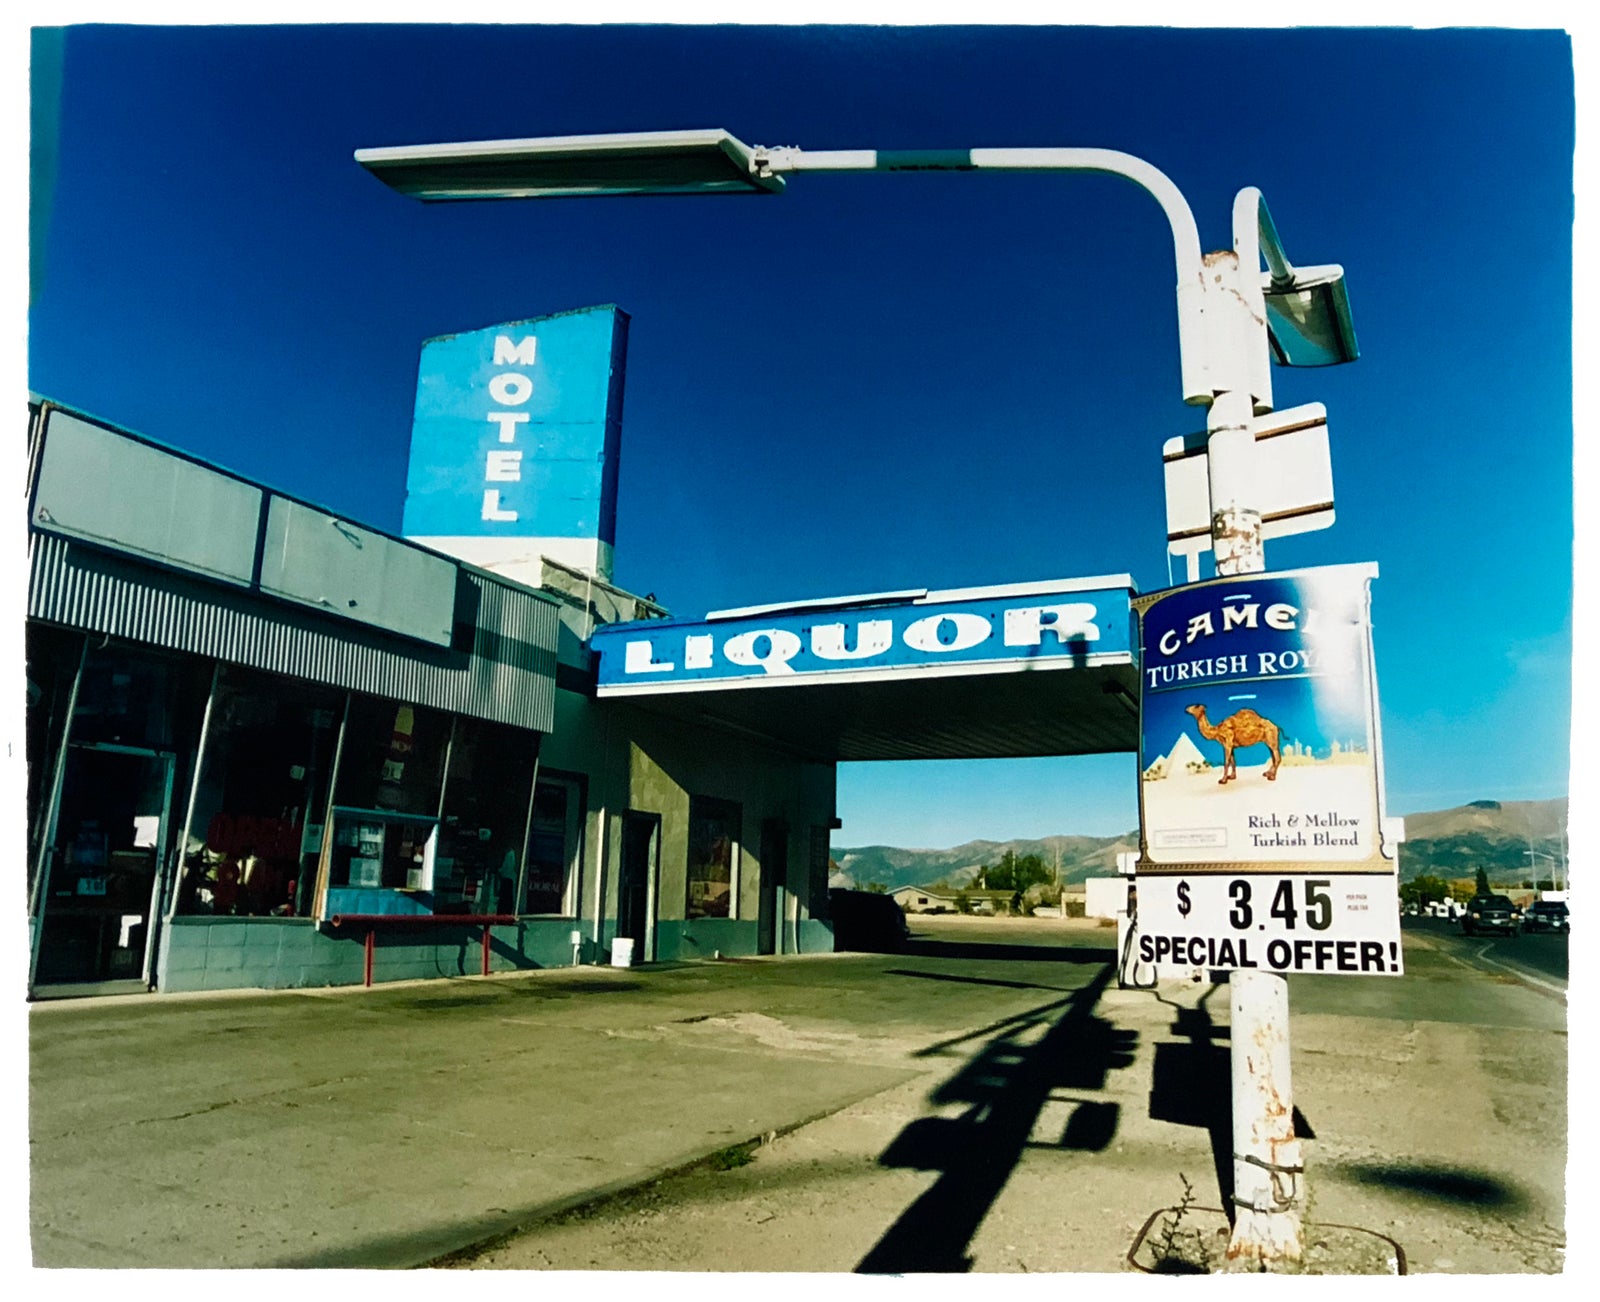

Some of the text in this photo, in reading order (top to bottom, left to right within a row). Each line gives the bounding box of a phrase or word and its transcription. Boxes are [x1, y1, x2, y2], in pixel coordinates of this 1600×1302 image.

[481, 335, 536, 521] MOTEL
[624, 602, 1100, 674] LIQUOR
[1147, 654, 1248, 688] TURKISH
[1248, 813, 1360, 829] Rich & Mellow
[1250, 831, 1358, 847] Turkish Blend
[1177, 880, 1332, 931] $ 3.45
[1139, 935, 1399, 972] SPECIAL OFFER!
